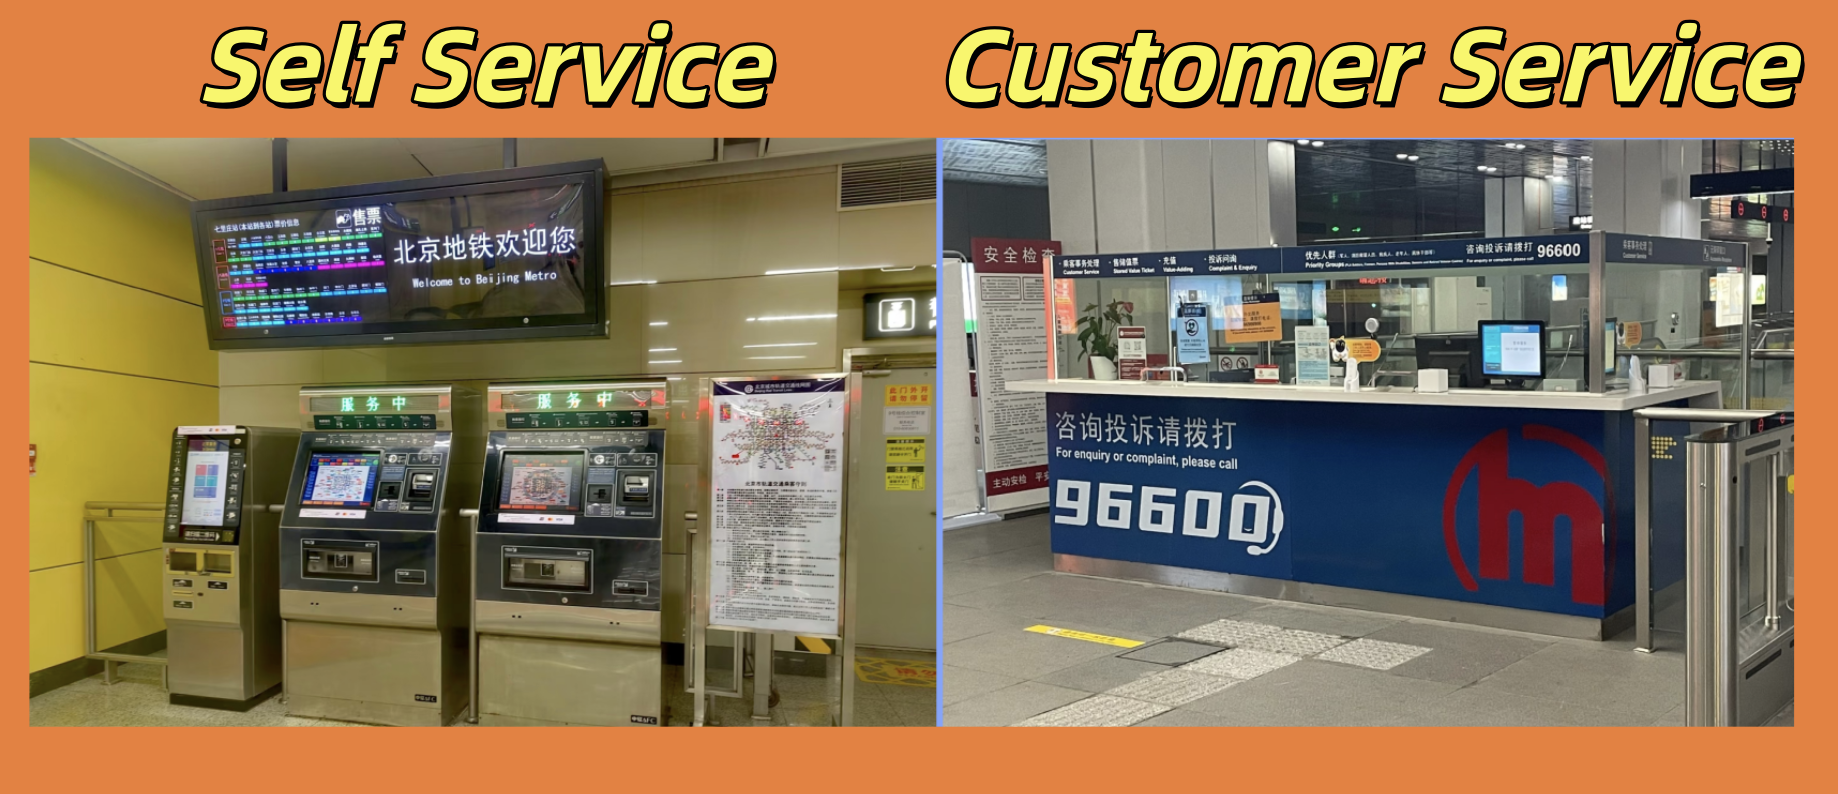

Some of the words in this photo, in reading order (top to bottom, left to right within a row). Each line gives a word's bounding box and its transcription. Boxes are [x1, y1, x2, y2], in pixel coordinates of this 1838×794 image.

[352, 206, 382, 226] 售票
[393, 225, 576, 265] 北京地铁欢迎您
[1466, 241, 1533, 255] 咨询投诉请拨打
[1537, 243, 1581, 258] 96600
[1162, 256, 1176, 266] 充值
[1208, 254, 1237, 264] 投诉问询
[1305, 250, 1336, 260] 优先人群
[1305, 261, 1324, 270] Priority
[1325, 260, 1345, 269] Groups
[412, 277, 453, 288] Welcome
[458, 276, 471, 285] to
[475, 273, 520, 287] Beijing
[524, 270, 557, 282] Metro
[889, 386, 928, 394] 此门外开
[889, 394, 928, 402] 请勿停留
[341, 396, 407, 412] 服务中
[537, 391, 613, 410] 服务中
[1055, 411, 1237, 450] 咨询投诉请拨打
[1056, 447, 1072, 458] For
[1074, 450, 1111, 463] enquiry
[1113, 452, 1124, 462] or
[1126, 452, 1179, 468] complaint,
[1181, 455, 1216, 469] please
[1218, 458, 1238, 470] call
[993, 471, 1027, 488] 主动安检
[1054, 479, 1270, 544] 96600
